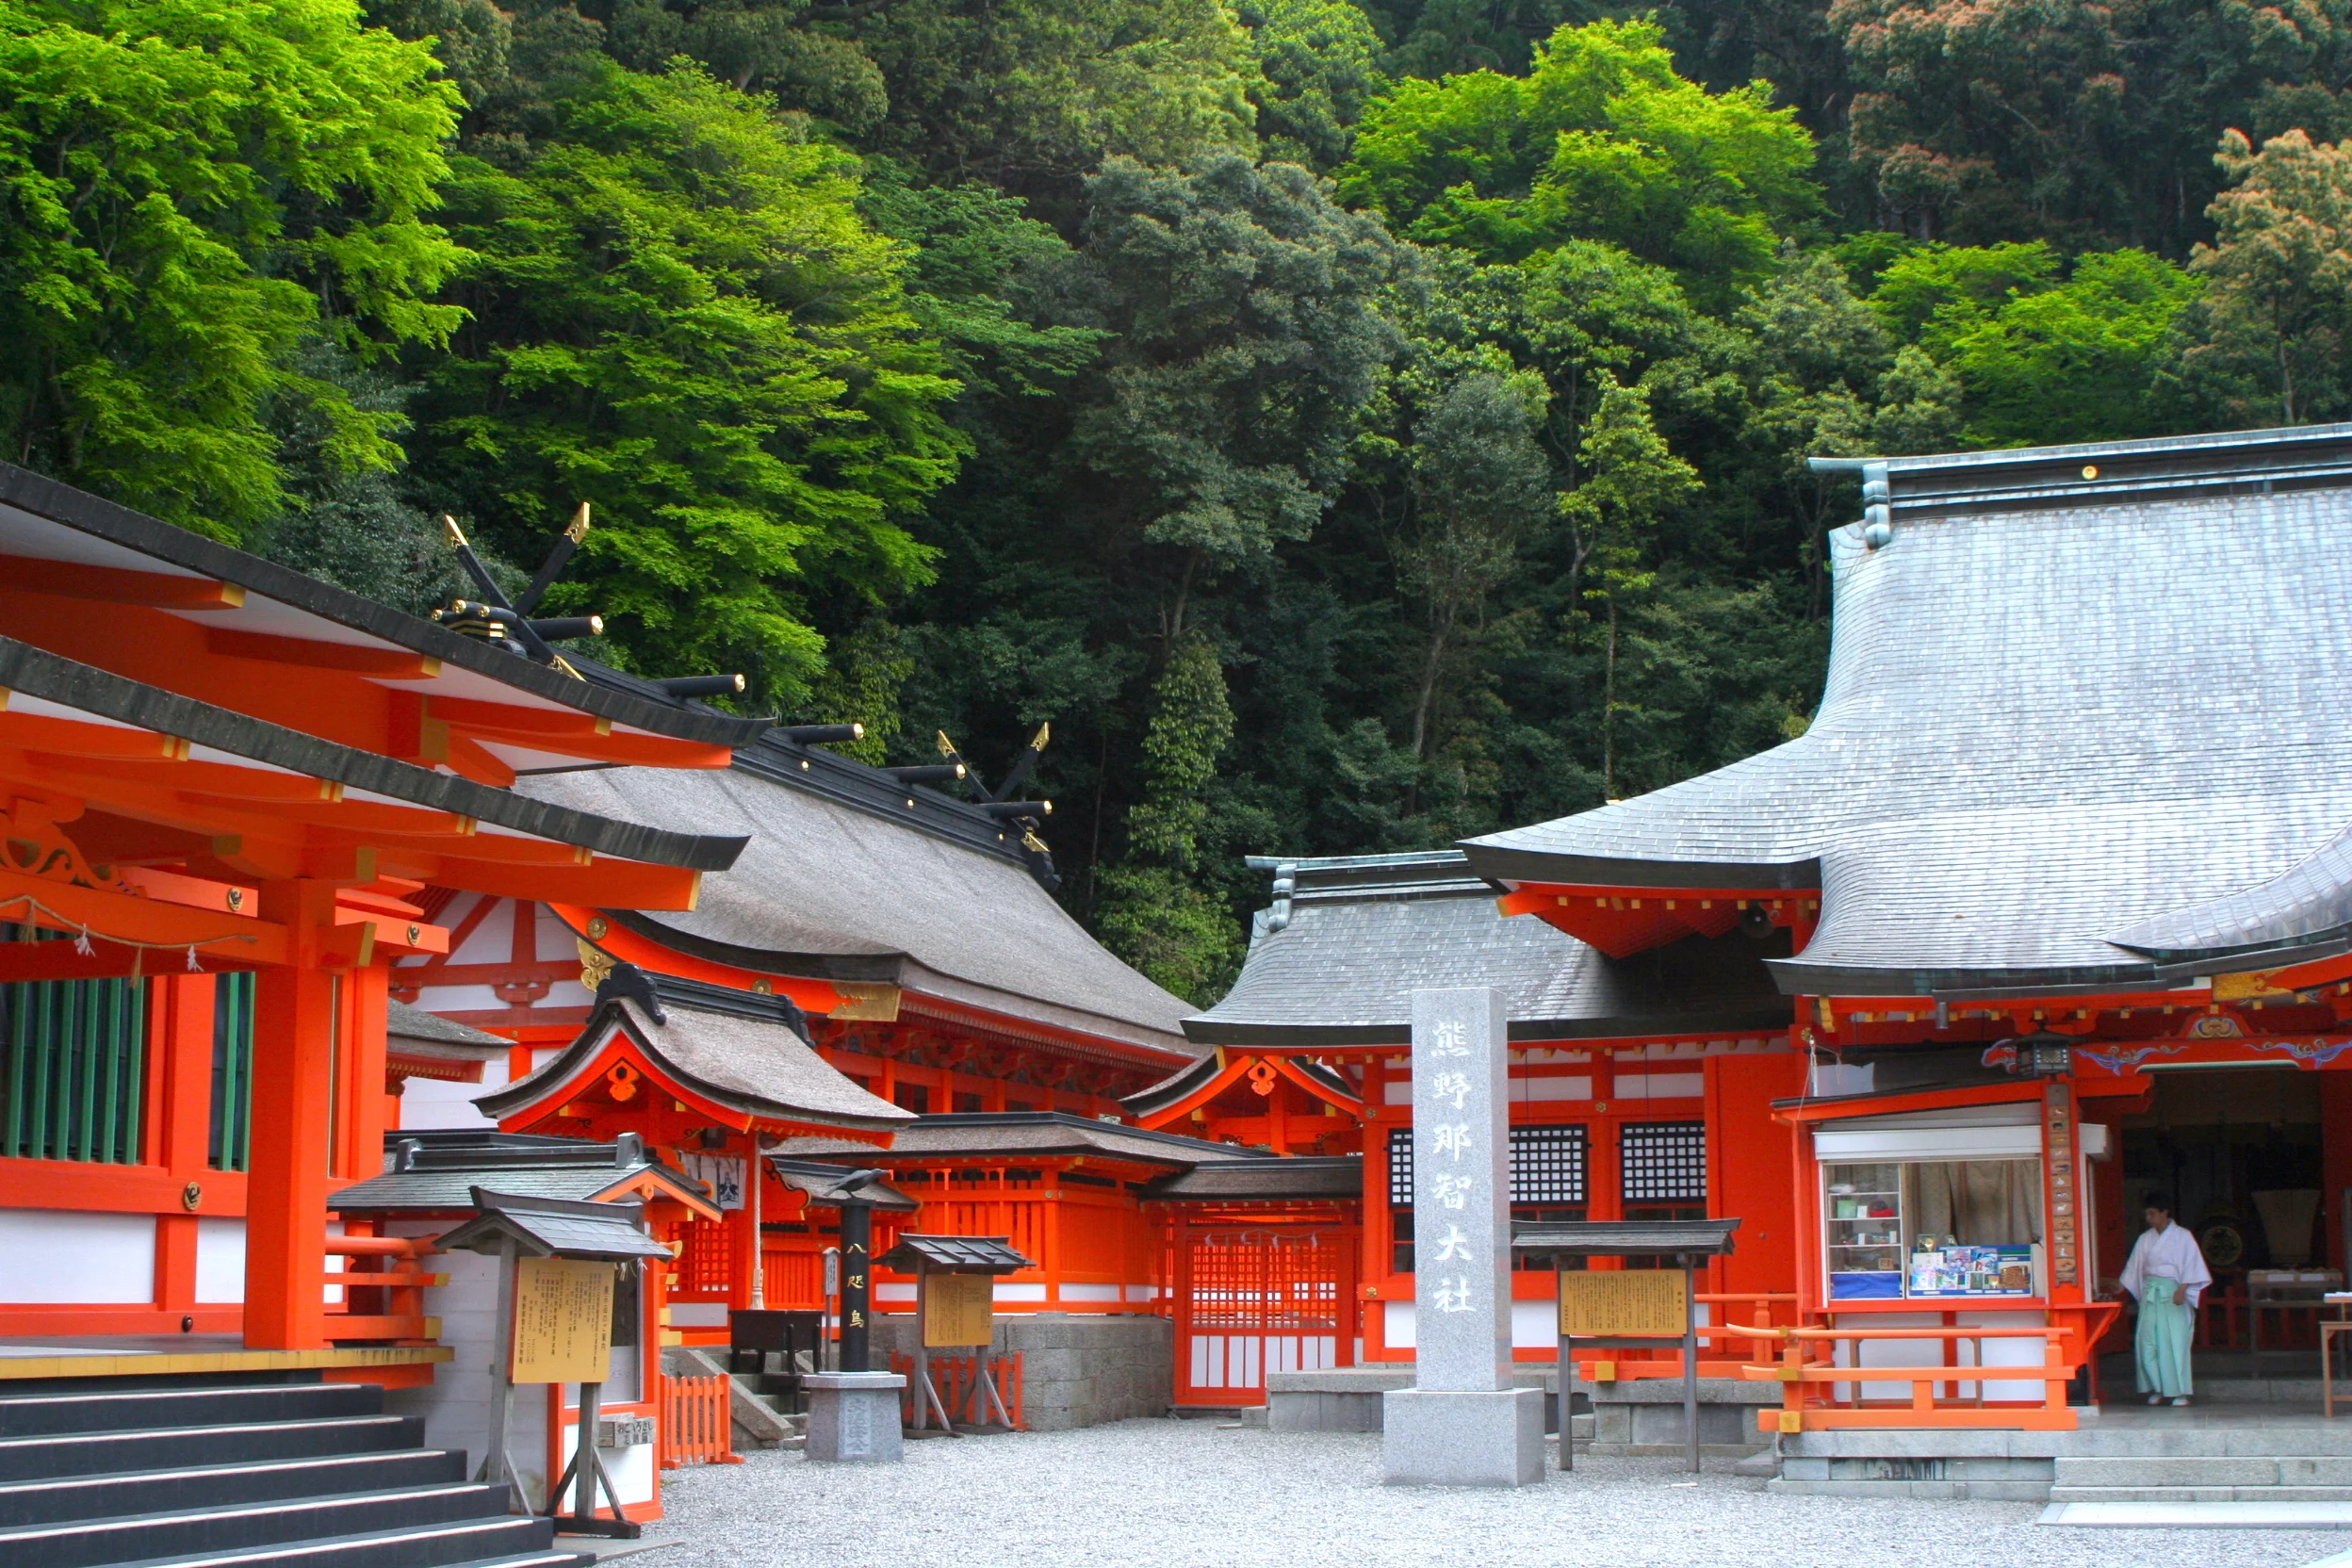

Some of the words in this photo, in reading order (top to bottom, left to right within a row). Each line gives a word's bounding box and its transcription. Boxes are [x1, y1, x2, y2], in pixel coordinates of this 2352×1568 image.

[1430, 1021, 1477, 1314] 熊野那智大社
[846, 1243, 868, 1329] 八咫烏
